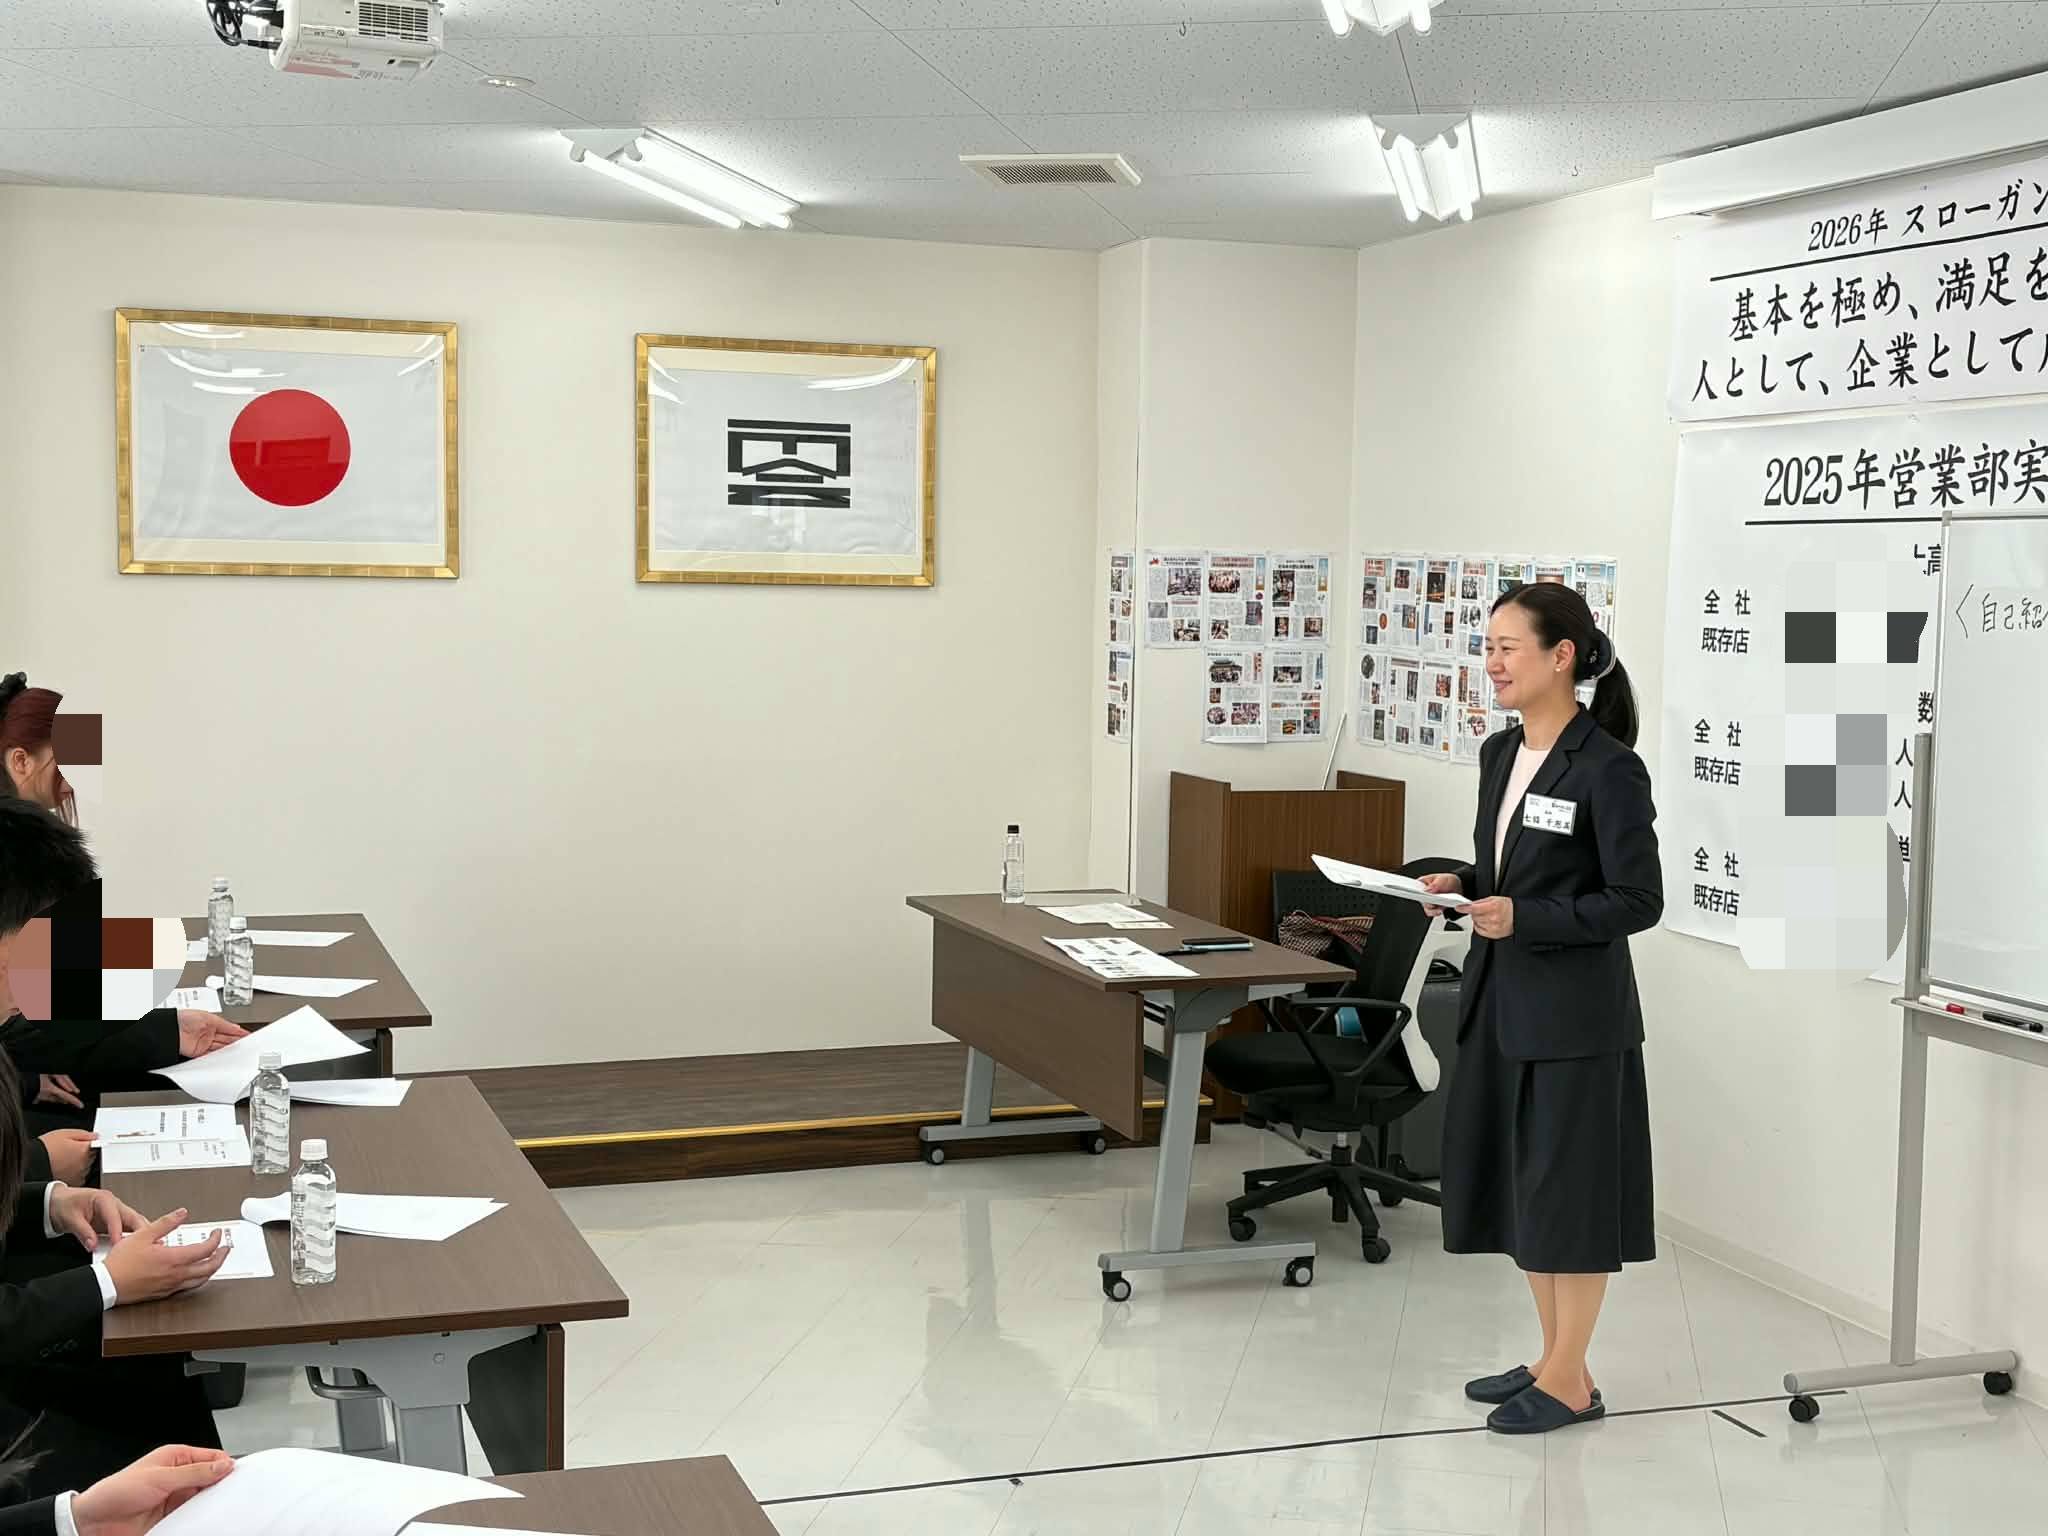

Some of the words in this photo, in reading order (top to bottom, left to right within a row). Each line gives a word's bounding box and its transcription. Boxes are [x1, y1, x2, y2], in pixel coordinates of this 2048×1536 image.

[1807, 207, 1889, 252] 2026年
[1692, 328, 2048, 402] 人として、企業として
[1763, 439, 2048, 510] 2025年営業部実
[1700, 626, 1751, 654] 既存店
[1694, 755, 1742, 786] 既存店
[1694, 883, 1740, 916] 既存店
